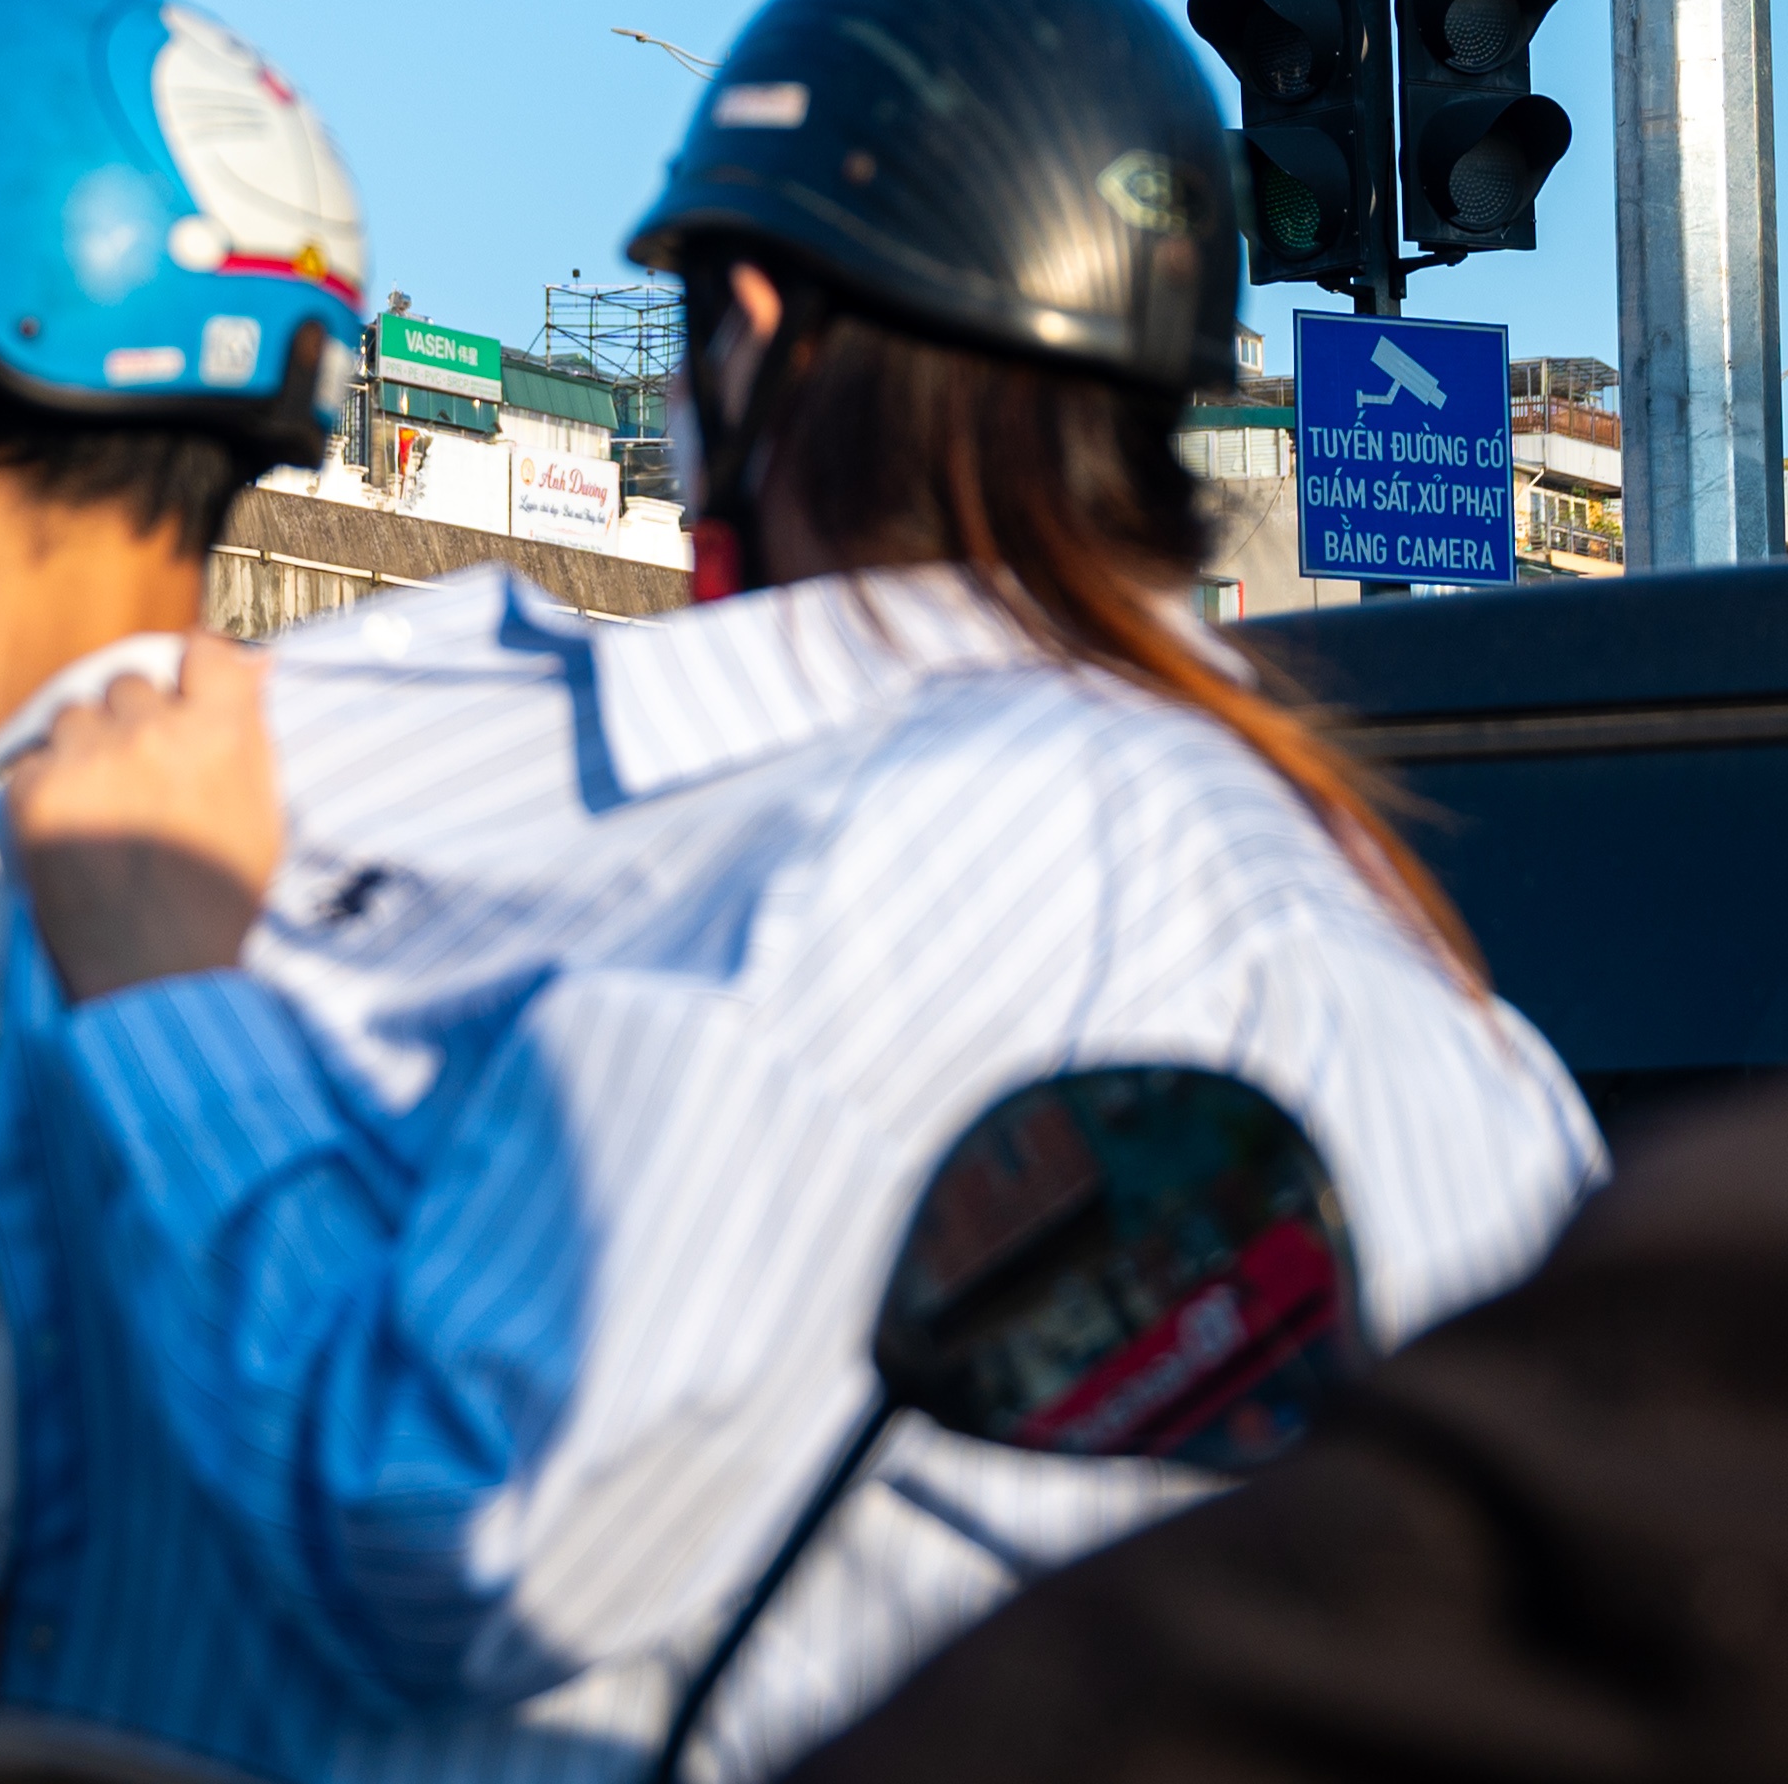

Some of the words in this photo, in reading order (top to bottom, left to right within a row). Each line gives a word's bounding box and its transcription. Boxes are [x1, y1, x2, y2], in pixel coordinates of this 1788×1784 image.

[405, 328, 457, 362] VASEN
[1308, 410, 1383, 462] TUYẾN
[1390, 421, 1468, 467] ĐƯỜNG
[1475, 428, 1504, 468] CÓ
[1306, 466, 1366, 509] GIÁM
[1452, 484, 1506, 525] PHẠT
[1324, 513, 1388, 565] BẰNG
[1396, 535, 1496, 571] CAMERA
